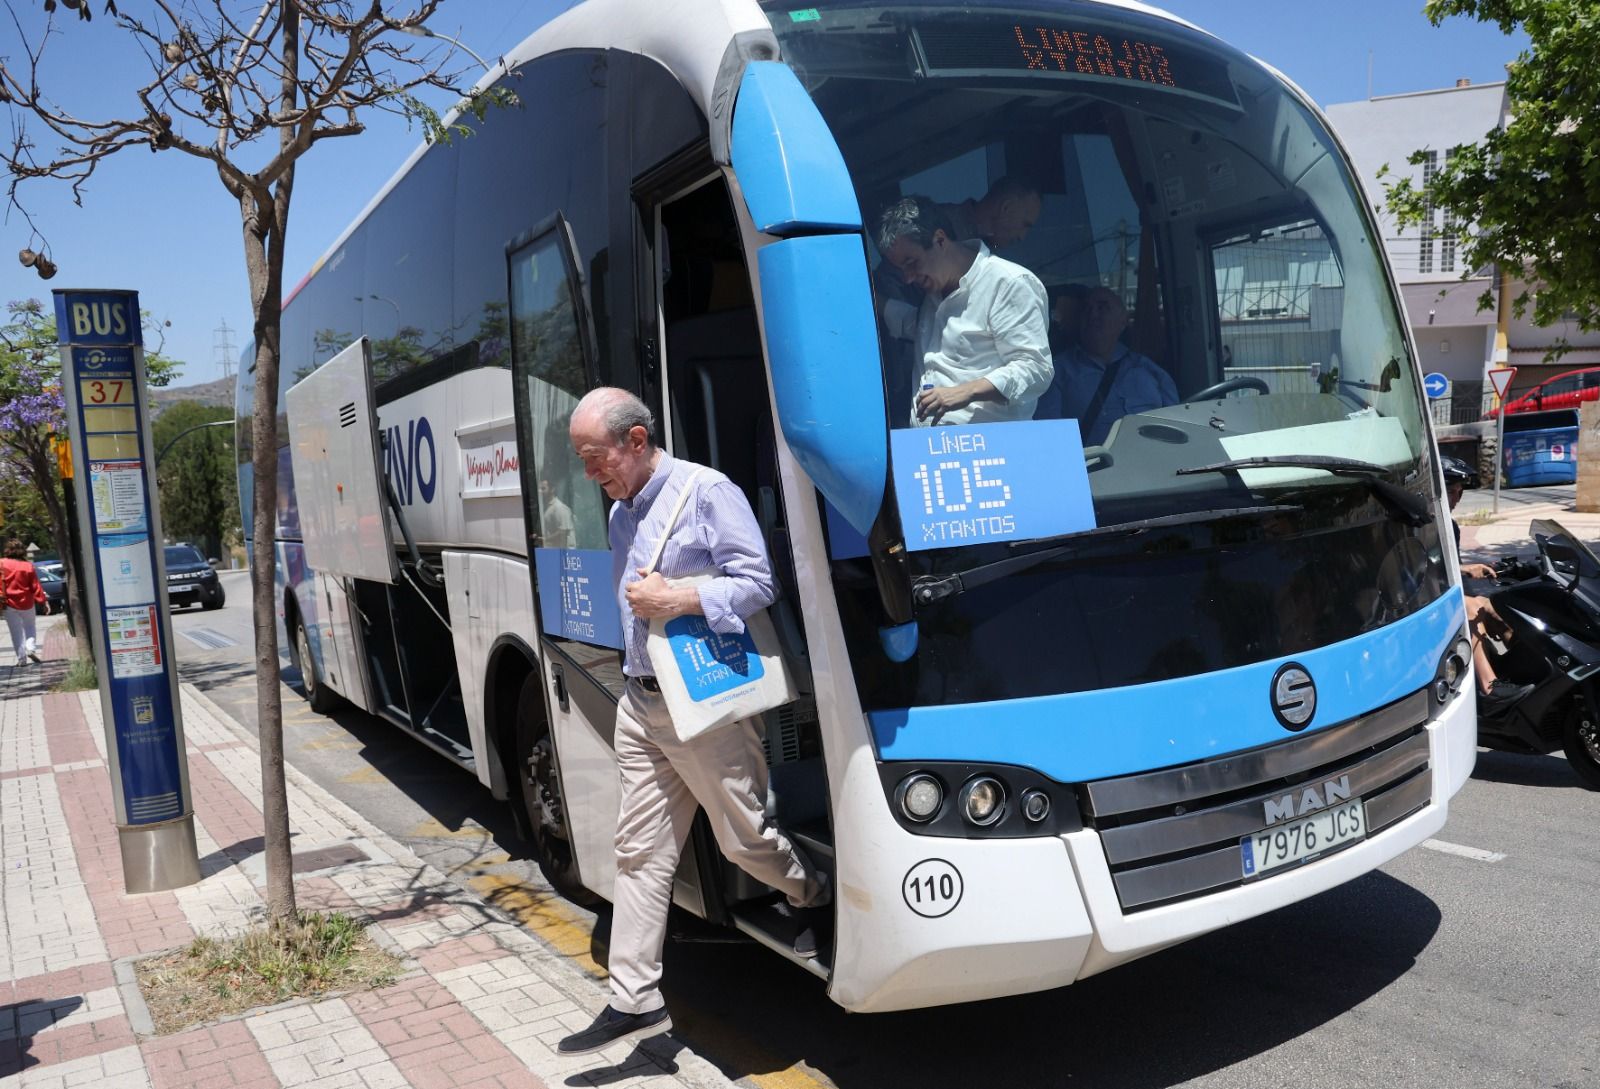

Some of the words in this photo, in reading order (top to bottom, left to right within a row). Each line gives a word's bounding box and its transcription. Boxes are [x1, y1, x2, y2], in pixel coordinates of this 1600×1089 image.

[1014, 24, 1112, 57] LINEA
[73, 302, 127, 336] BUS
[90, 380, 124, 403] 37
[928, 431, 986, 455] LÍNEA
[914, 457, 1011, 515] 105
[921, 515, 1016, 542] XTANTOS
[560, 575, 592, 617] 105
[565, 619, 595, 638] XTANTOS
[683, 632, 743, 672] 105
[696, 660, 748, 688] XTANTOS
[1263, 775, 1351, 826] MAN
[1258, 821, 1317, 866] 7976
[1325, 805, 1360, 843] JCS
[909, 873, 954, 903] 110
